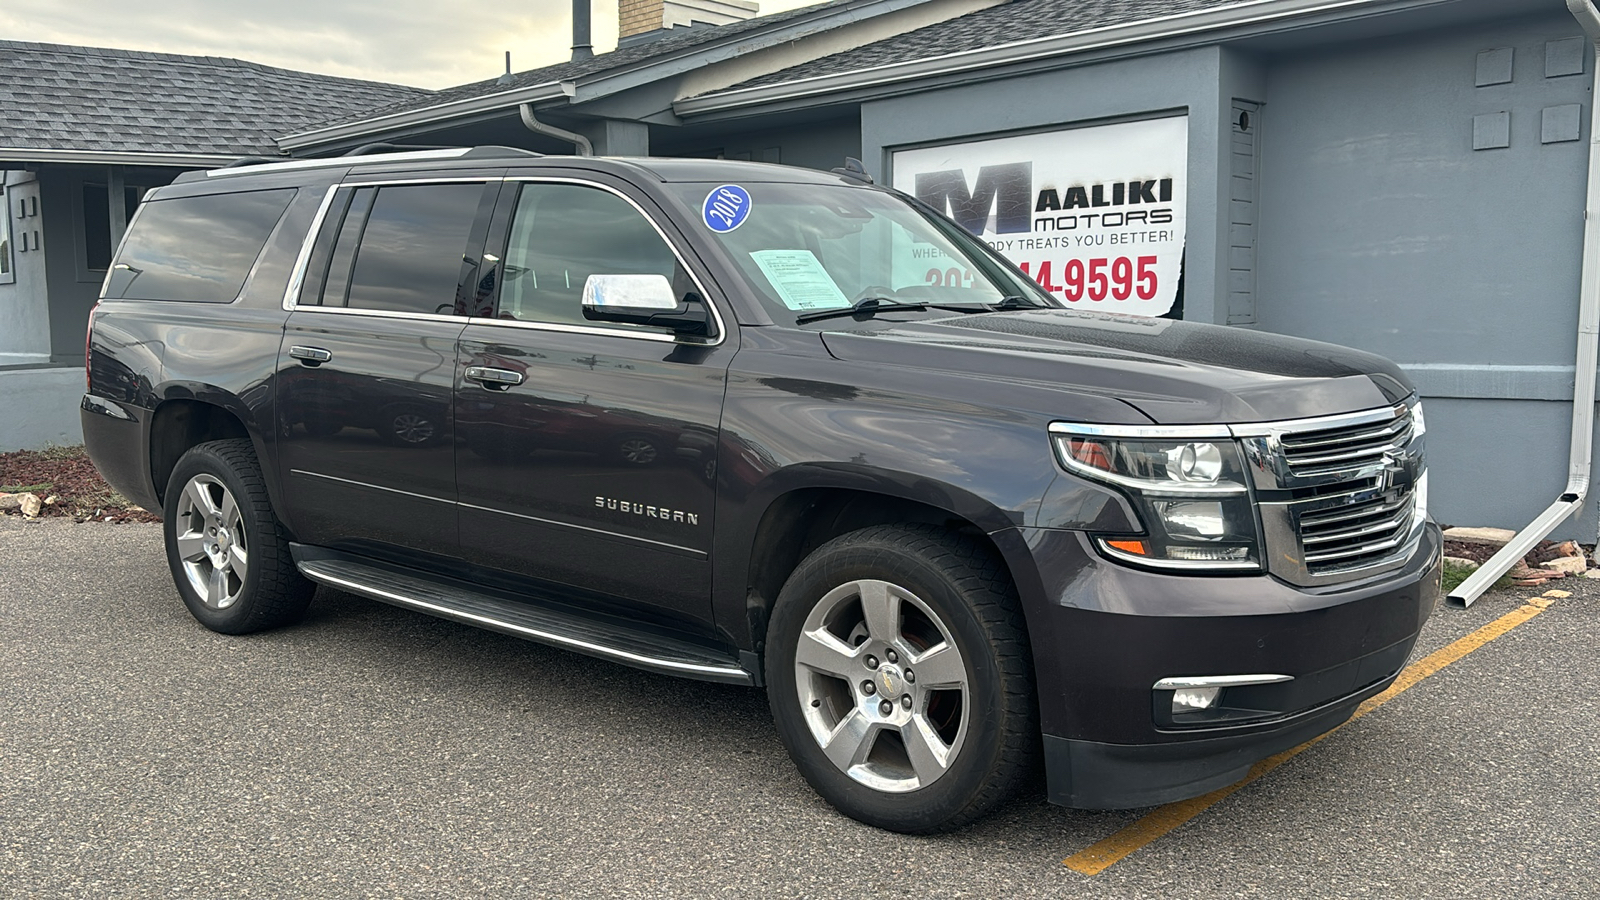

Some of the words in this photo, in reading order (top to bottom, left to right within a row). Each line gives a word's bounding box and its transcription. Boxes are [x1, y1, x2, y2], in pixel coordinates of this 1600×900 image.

[707, 188, 743, 228] 2018
[1035, 209, 1173, 232] MOTORS
[1018, 236, 1070, 250] TREATS
[1075, 234, 1105, 247] YOU
[1110, 231, 1174, 244] BETTER!
[595, 496, 698, 525] SUBURBAN
